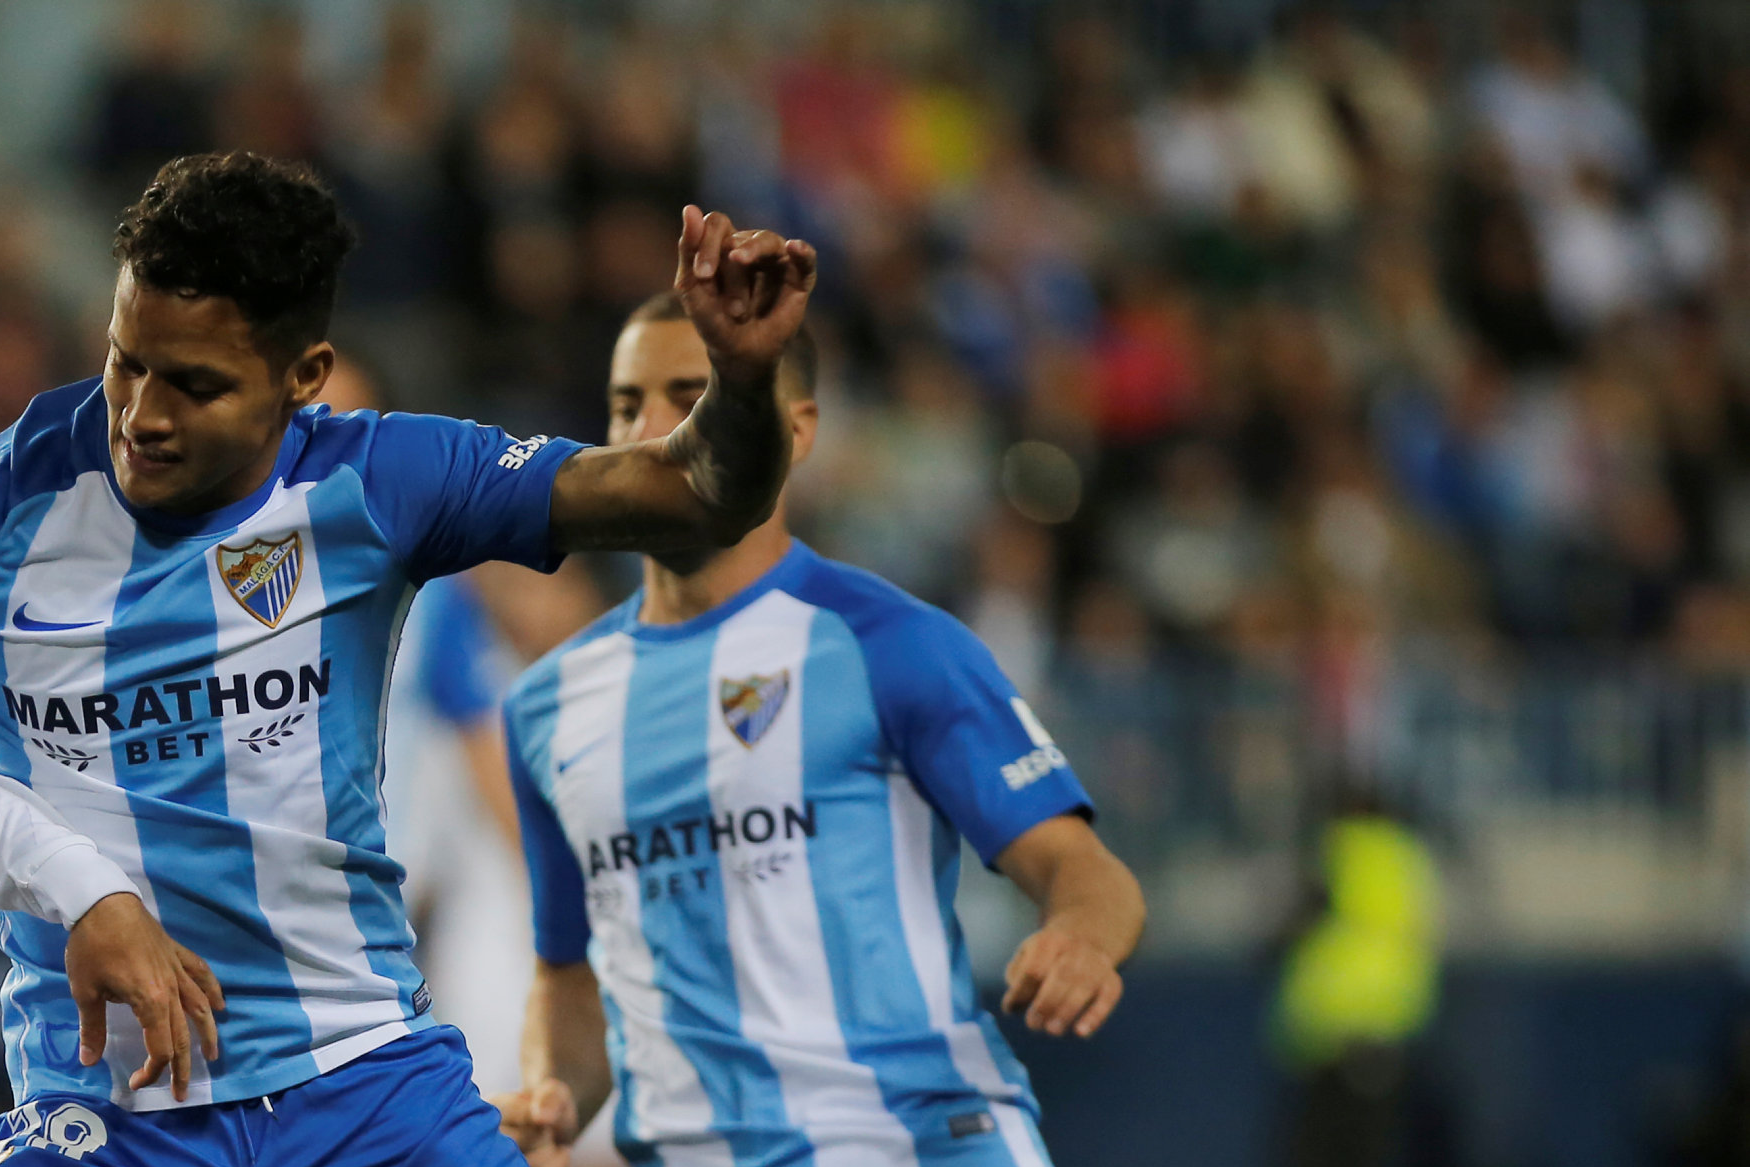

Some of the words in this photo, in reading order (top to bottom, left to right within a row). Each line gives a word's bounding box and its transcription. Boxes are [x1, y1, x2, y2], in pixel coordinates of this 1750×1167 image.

[125, 732, 209, 766] BET
[587, 800, 818, 879] ARATHON
[645, 866, 710, 901] BET
